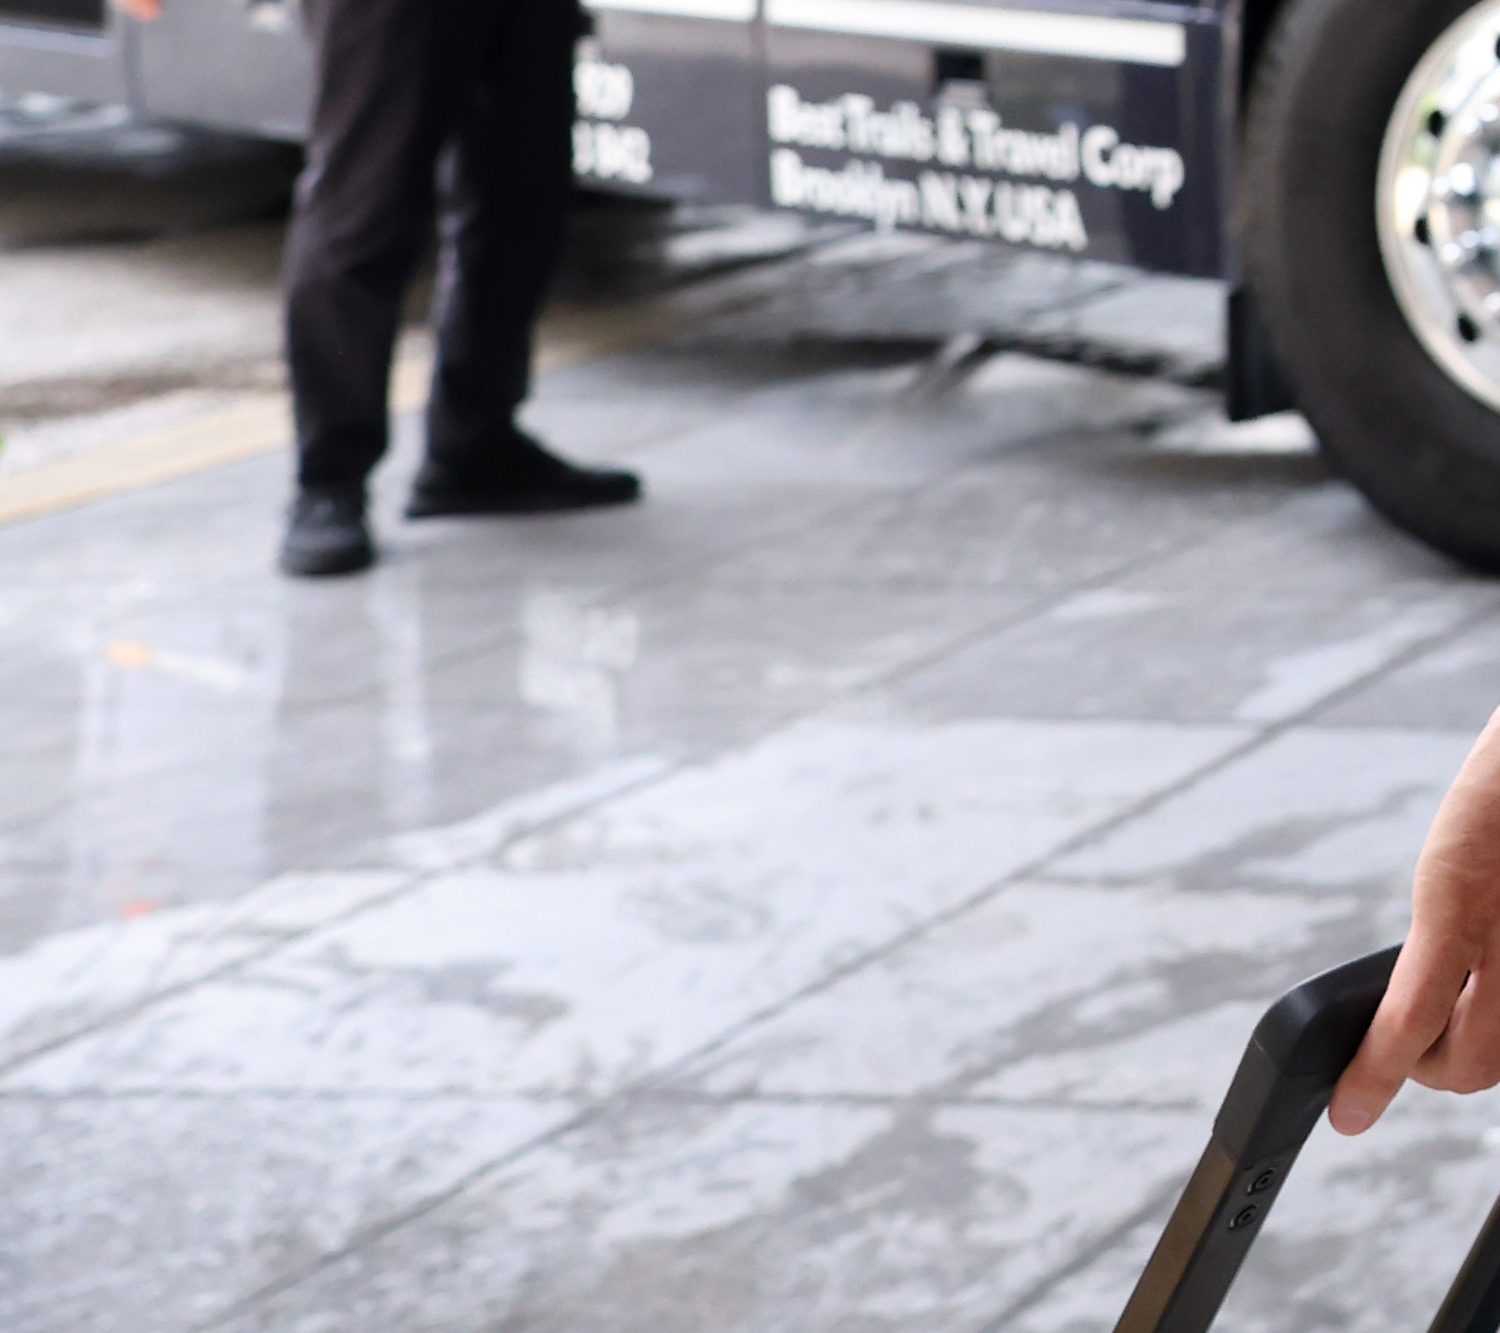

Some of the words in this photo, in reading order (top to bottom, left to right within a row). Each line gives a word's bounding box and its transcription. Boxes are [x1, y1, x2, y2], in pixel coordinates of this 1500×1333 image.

[768, 84, 844, 150] Best
[937, 105, 970, 167] &
[966, 109, 1079, 183] Travel
[1081, 126, 1184, 210] Corp
[769, 149, 919, 233] Brooklyn
